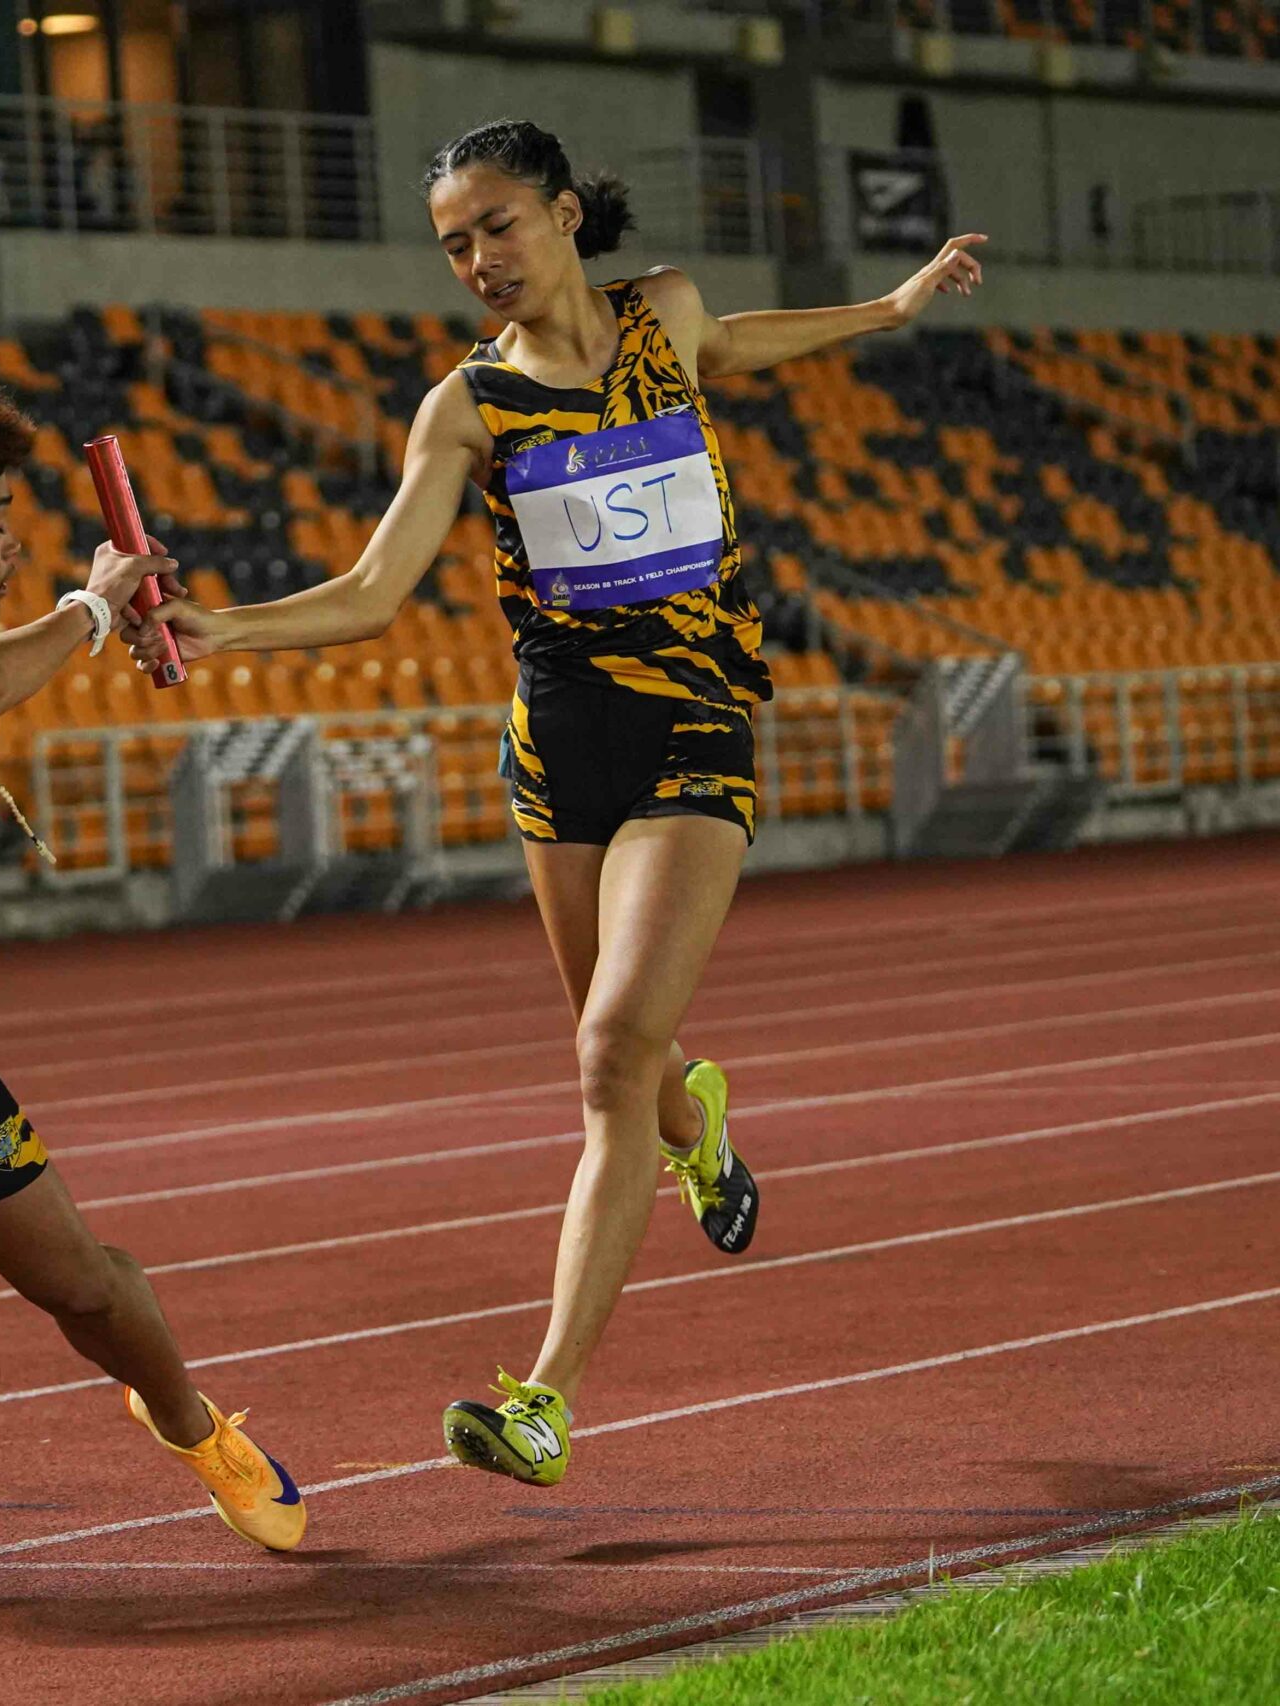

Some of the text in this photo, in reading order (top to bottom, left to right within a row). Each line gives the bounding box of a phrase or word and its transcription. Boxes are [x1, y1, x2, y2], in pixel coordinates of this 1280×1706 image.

[563, 472, 676, 552] UST
[573, 583, 601, 591] SEASON
[613, 577, 637, 587] TRACK
[645, 570, 664, 580] FIELD
[167, 664, 177, 680] 8
[722, 1213, 745, 1249] TEAM
